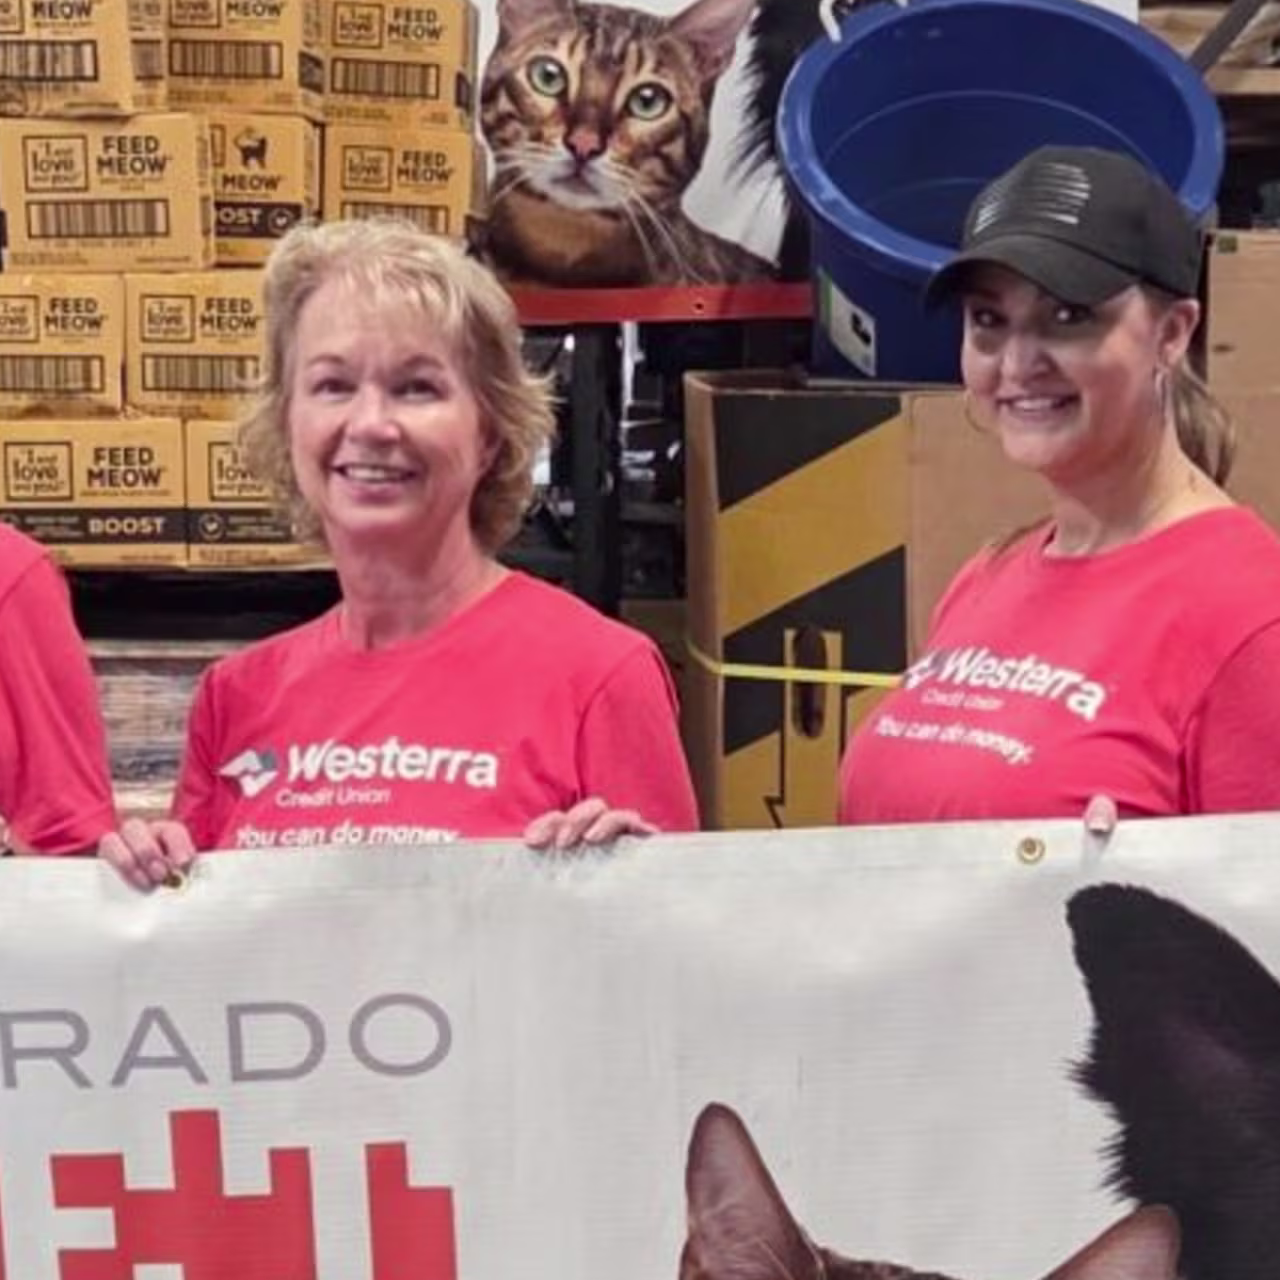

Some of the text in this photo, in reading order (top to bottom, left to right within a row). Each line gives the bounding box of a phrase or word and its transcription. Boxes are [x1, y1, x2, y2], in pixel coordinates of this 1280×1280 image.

[102, 135, 160, 154] FEED
[96, 155, 167, 176] MEOW
[221, 174, 281, 192] MEOW
[49, 297, 99, 314] FEED
[205, 296, 254, 314] FEED
[44, 314, 102, 331] MEOW
[200, 314, 257, 332] MEOW
[93, 446, 155, 467] FEED
[13, 458, 59, 481] love
[86, 468, 163, 489] MEOW
[88, 517, 166, 535] BOOST
[937, 646, 1106, 722] Westerra
[876, 716, 905, 737] You
[905, 723, 940, 741] can
[287, 736, 499, 788] Westerra
[275, 788, 391, 808] Credit Union
[236, 824, 274, 847] You
[280, 827, 325, 846] can
[331, 820, 360, 845] do
